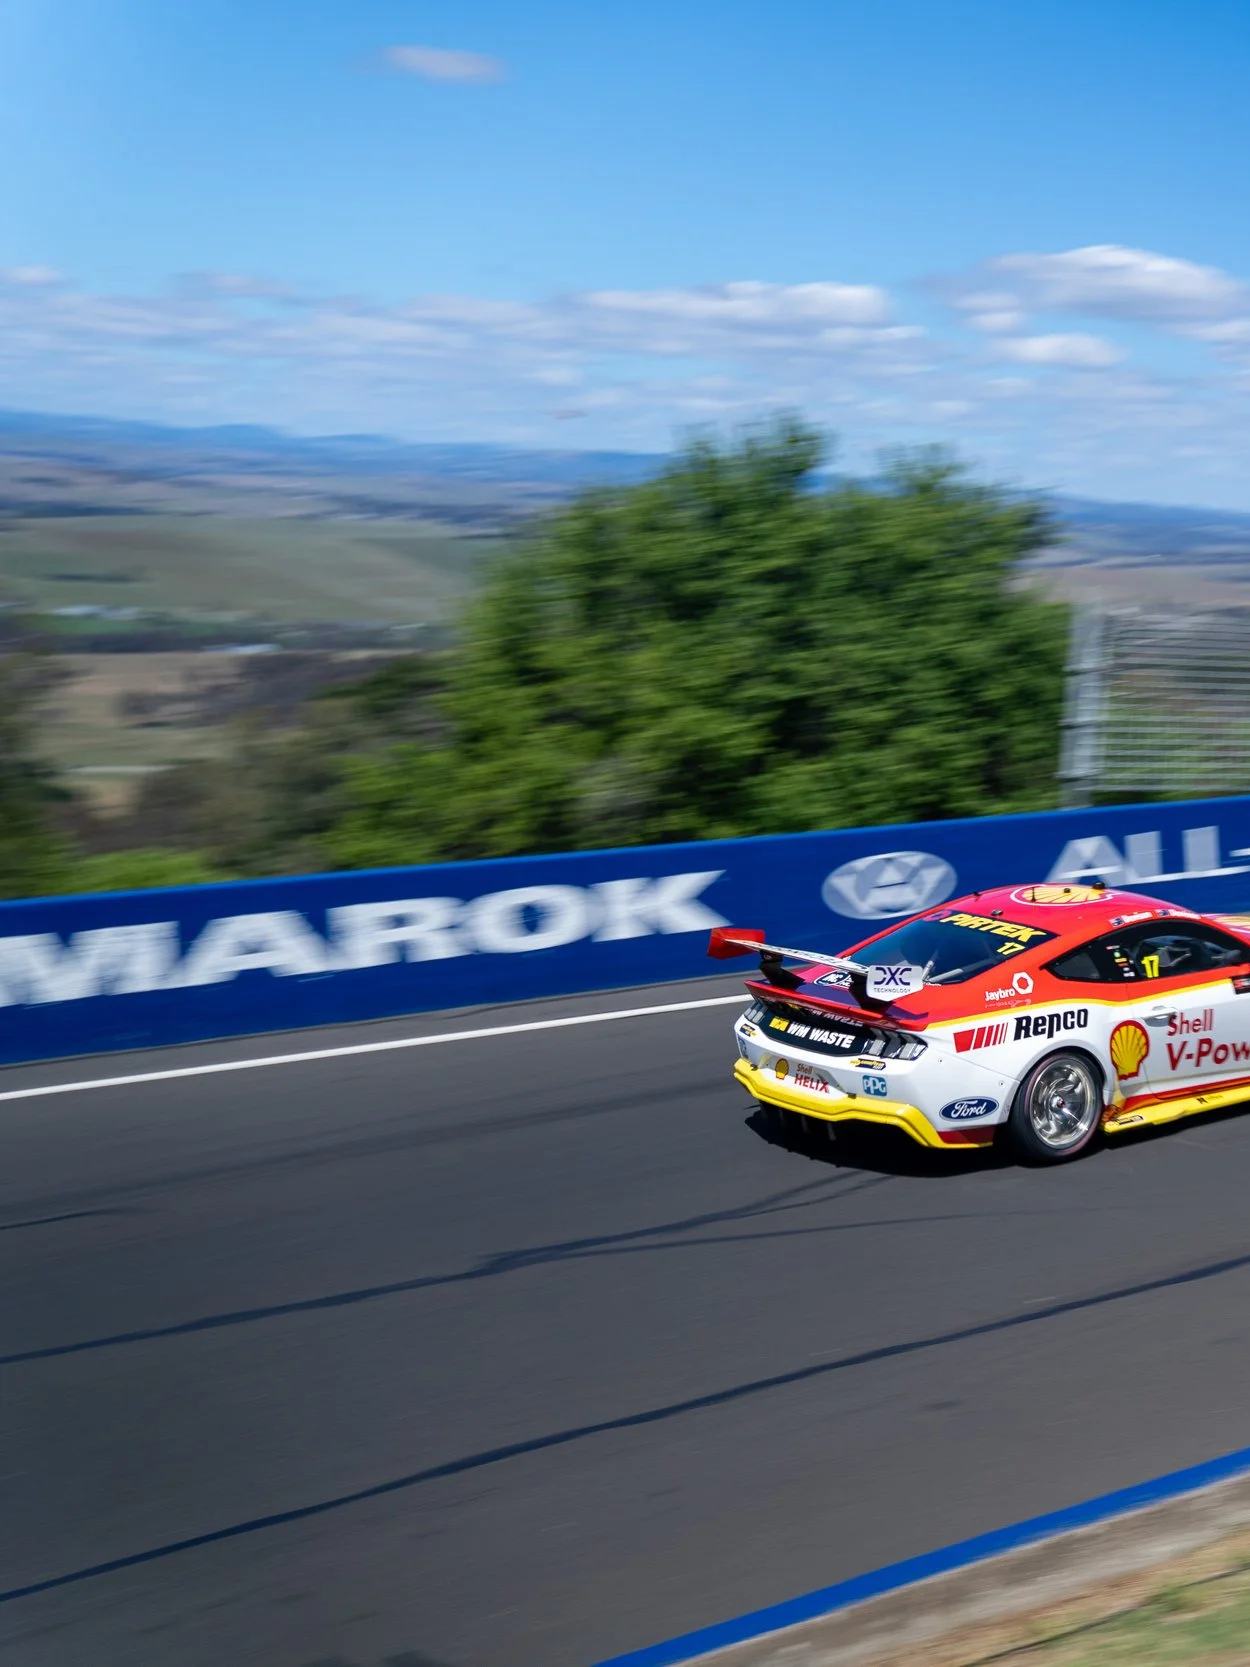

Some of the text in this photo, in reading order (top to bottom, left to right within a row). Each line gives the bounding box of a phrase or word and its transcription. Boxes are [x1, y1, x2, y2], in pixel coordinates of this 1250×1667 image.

[939, 913, 1047, 942] PIRTEK
[996, 942, 1025, 955] 17
[1141, 955, 1159, 978] 17
[985, 988, 1015, 1001] Jaybro
[1013, 1008, 1089, 1042] Repco
[1167, 1008, 1214, 1036] Shell
[787, 1021, 855, 1048] WM WASTE
[796, 1063, 814, 1074] Shell
[794, 1073, 830, 1094] HELIX
[863, 1076, 887, 1095] PPG
[950, 1100, 987, 1119] Ford
